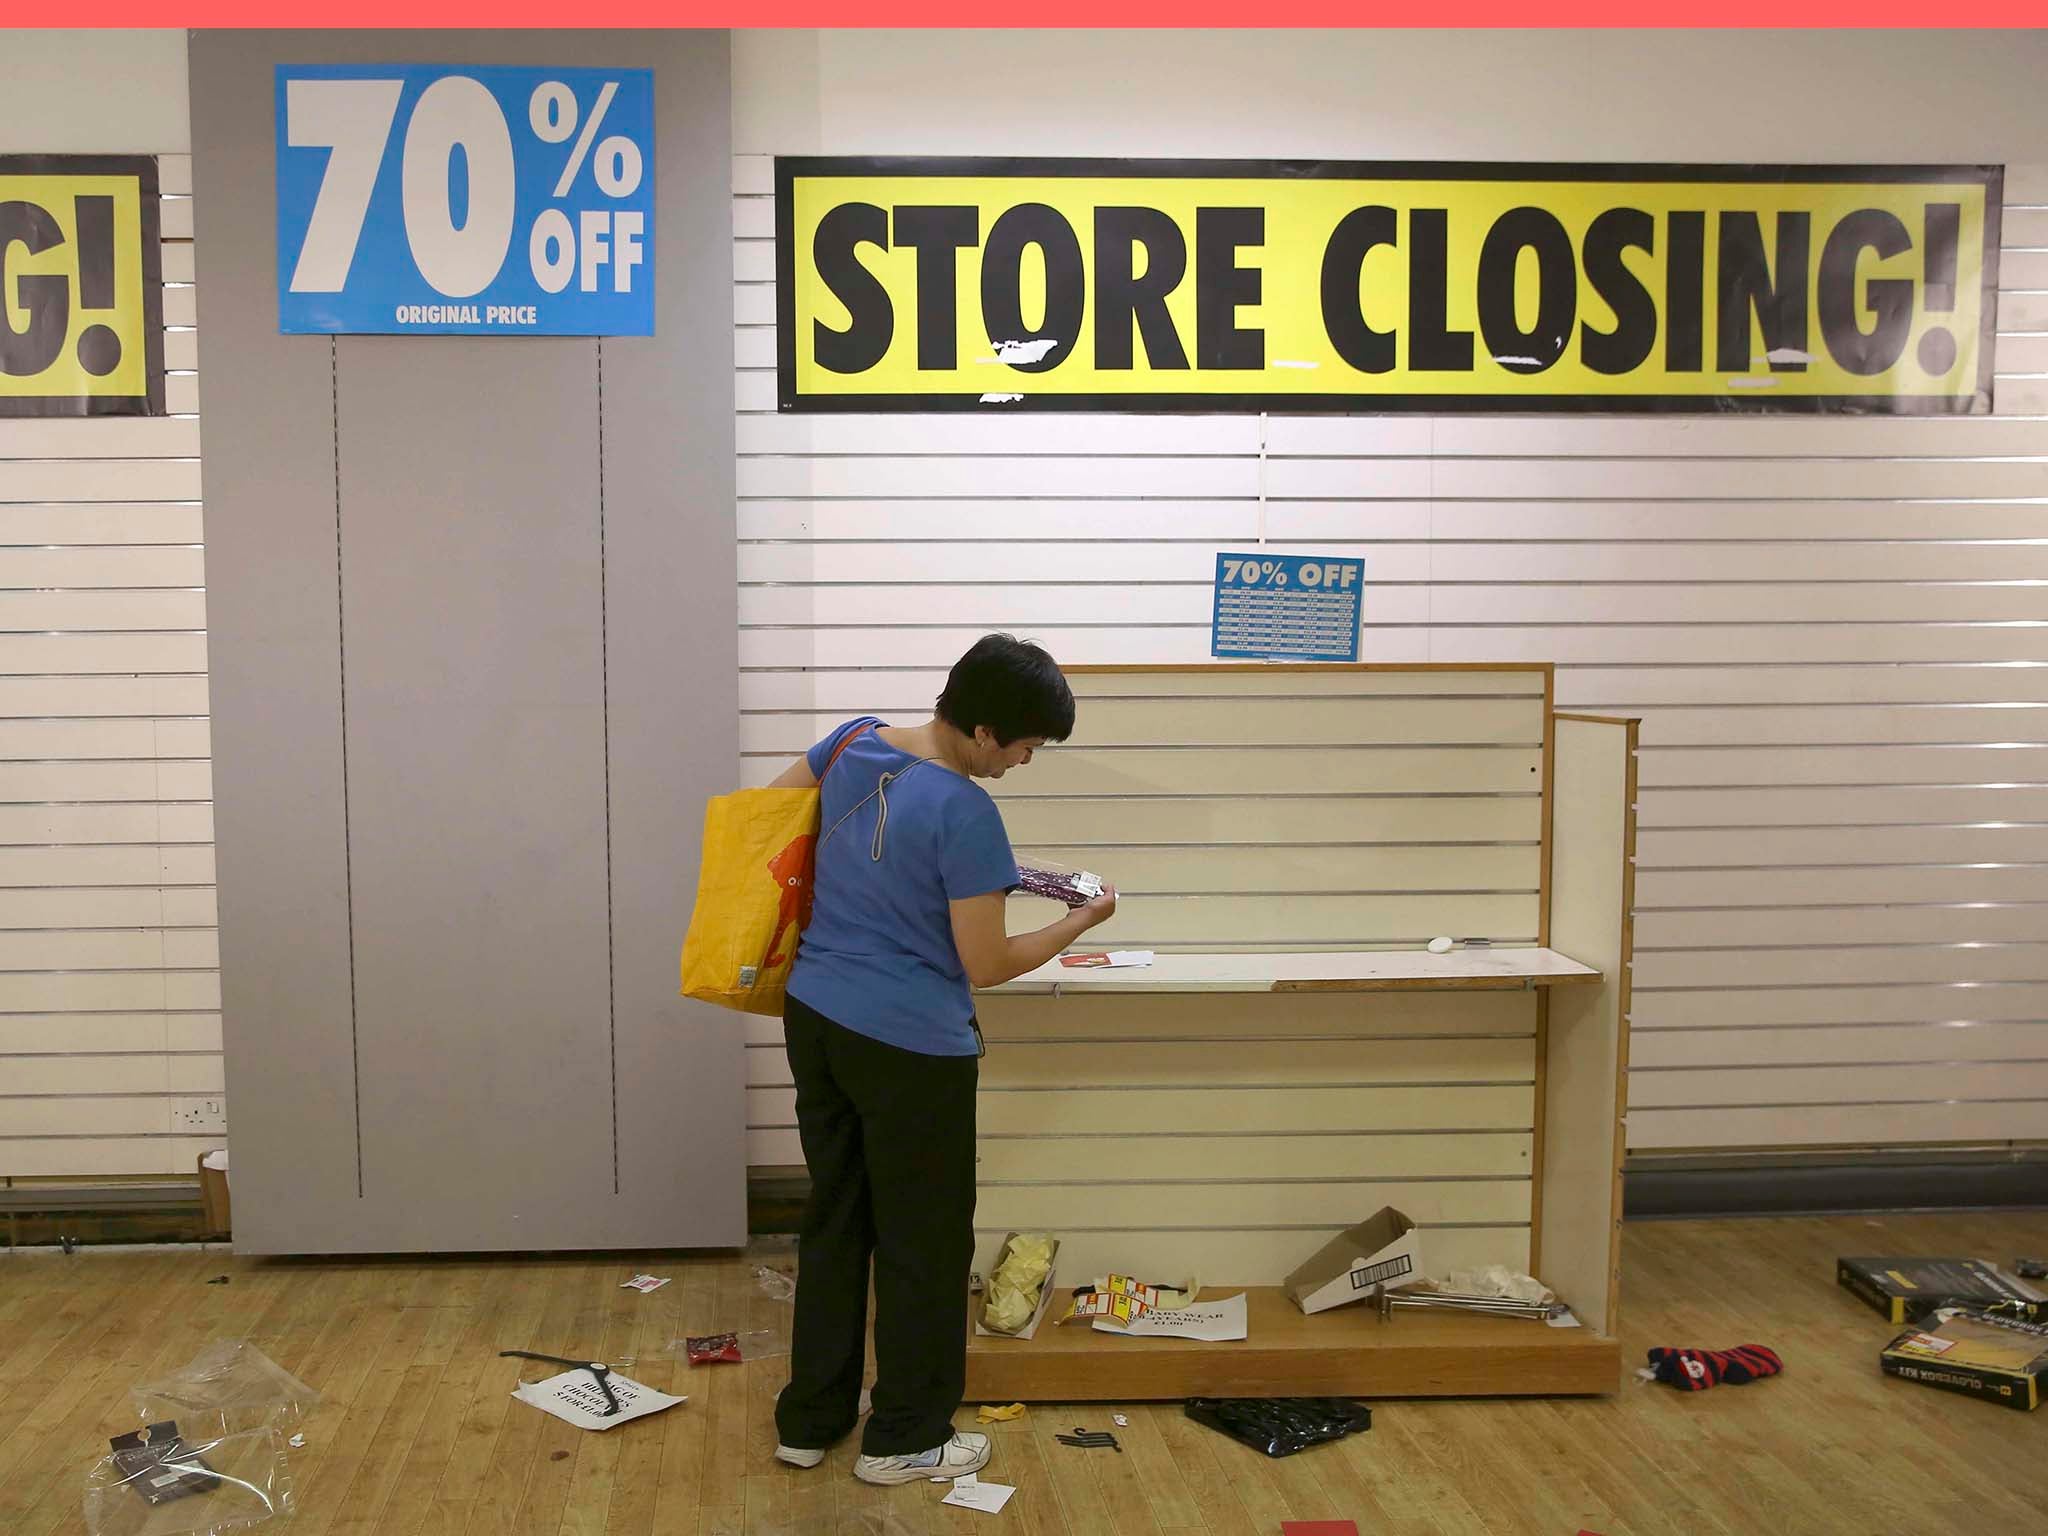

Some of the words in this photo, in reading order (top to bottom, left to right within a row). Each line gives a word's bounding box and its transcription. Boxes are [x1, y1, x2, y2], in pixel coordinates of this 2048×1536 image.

[287, 75, 643, 298] 70%
[529, 208, 644, 294] OFF
[0, 195, 122, 377] G!
[396, 305, 481, 324] ORIGINAL
[486, 305, 537, 324] PRICE
[813, 202, 1265, 374] STORE
[1320, 203, 1961, 377] CLOSING!
[1223, 560, 1288, 586] 70%
[1298, 563, 1358, 588] OFF
[1898, 1366, 1919, 1379] KIT
[1920, 1368, 1983, 1390] GLOVEBOX
